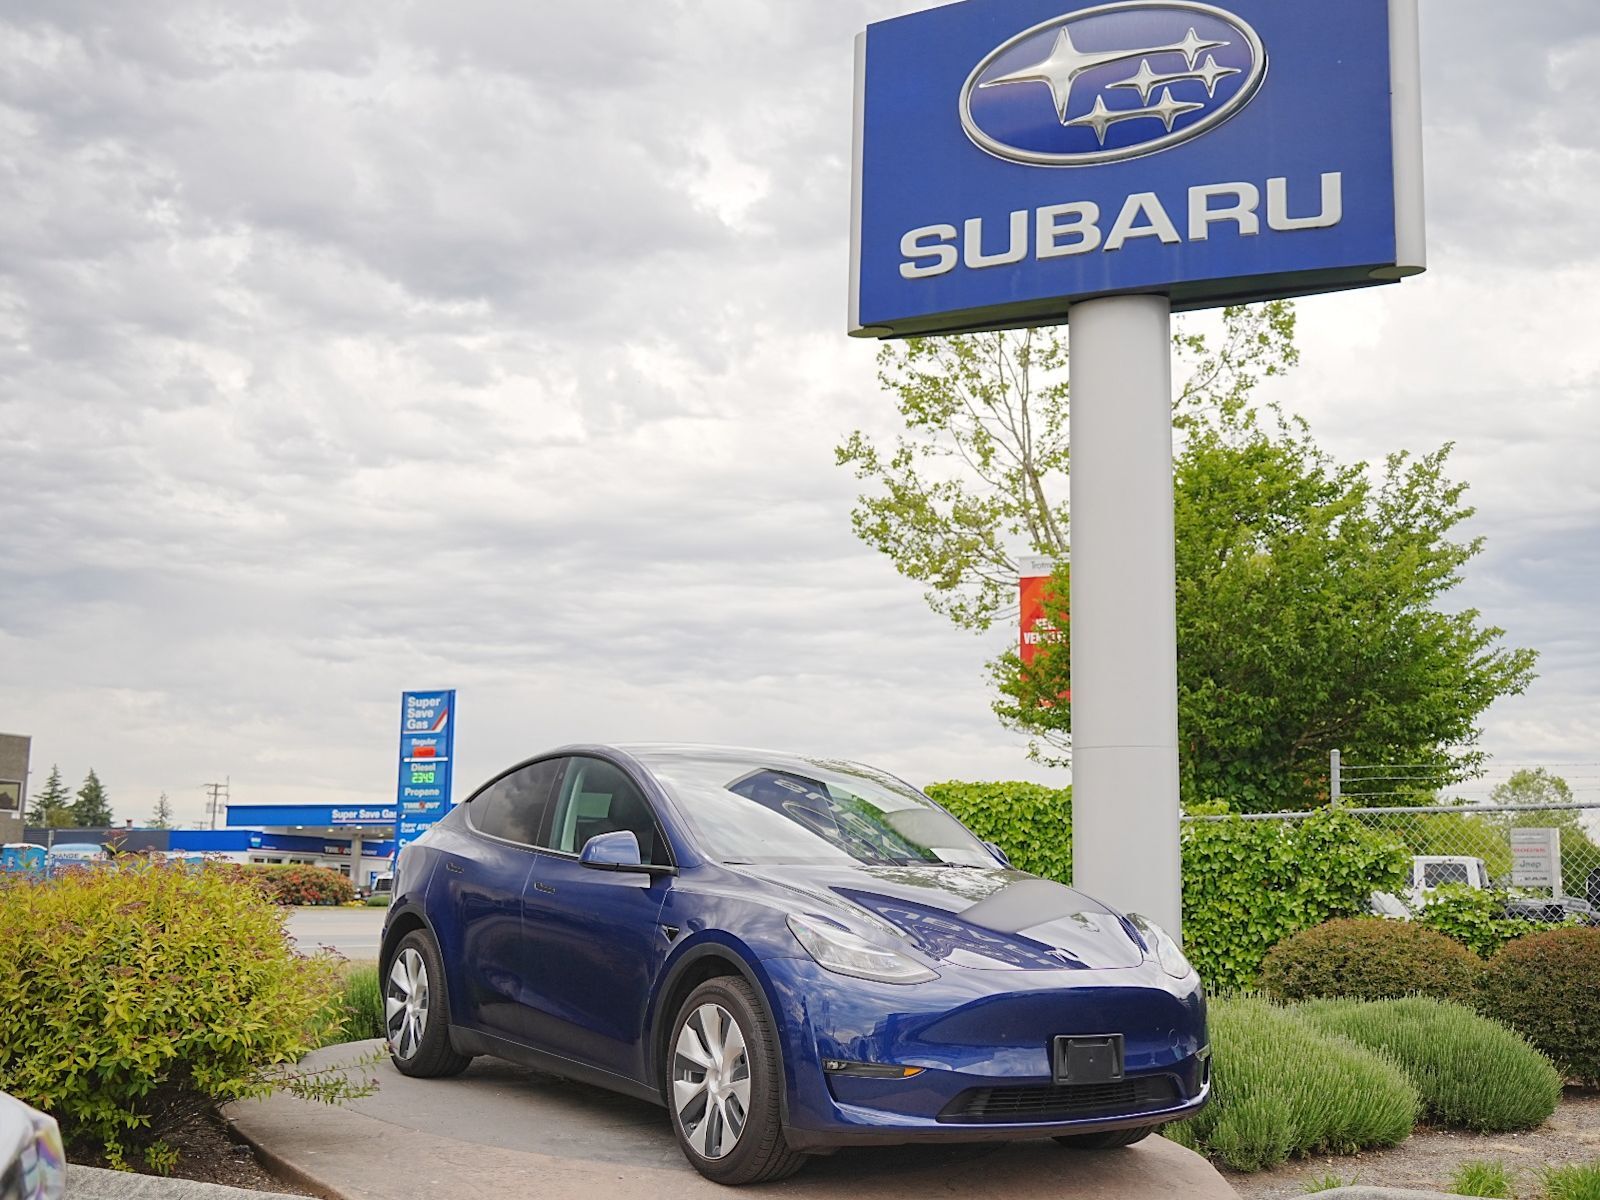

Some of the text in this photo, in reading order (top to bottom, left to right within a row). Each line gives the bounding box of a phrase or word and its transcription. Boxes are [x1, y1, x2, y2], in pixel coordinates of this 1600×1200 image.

[899, 172, 1341, 280] SUBARU
[408, 696, 441, 709] Super
[407, 708, 434, 719] Save
[407, 719, 428, 730] Gas
[412, 739, 437, 748] Regular
[411, 763, 436, 772] Diesel
[404, 787, 440, 798] Propane
[332, 809, 358, 821] Super
[359, 809, 381, 819] Save
